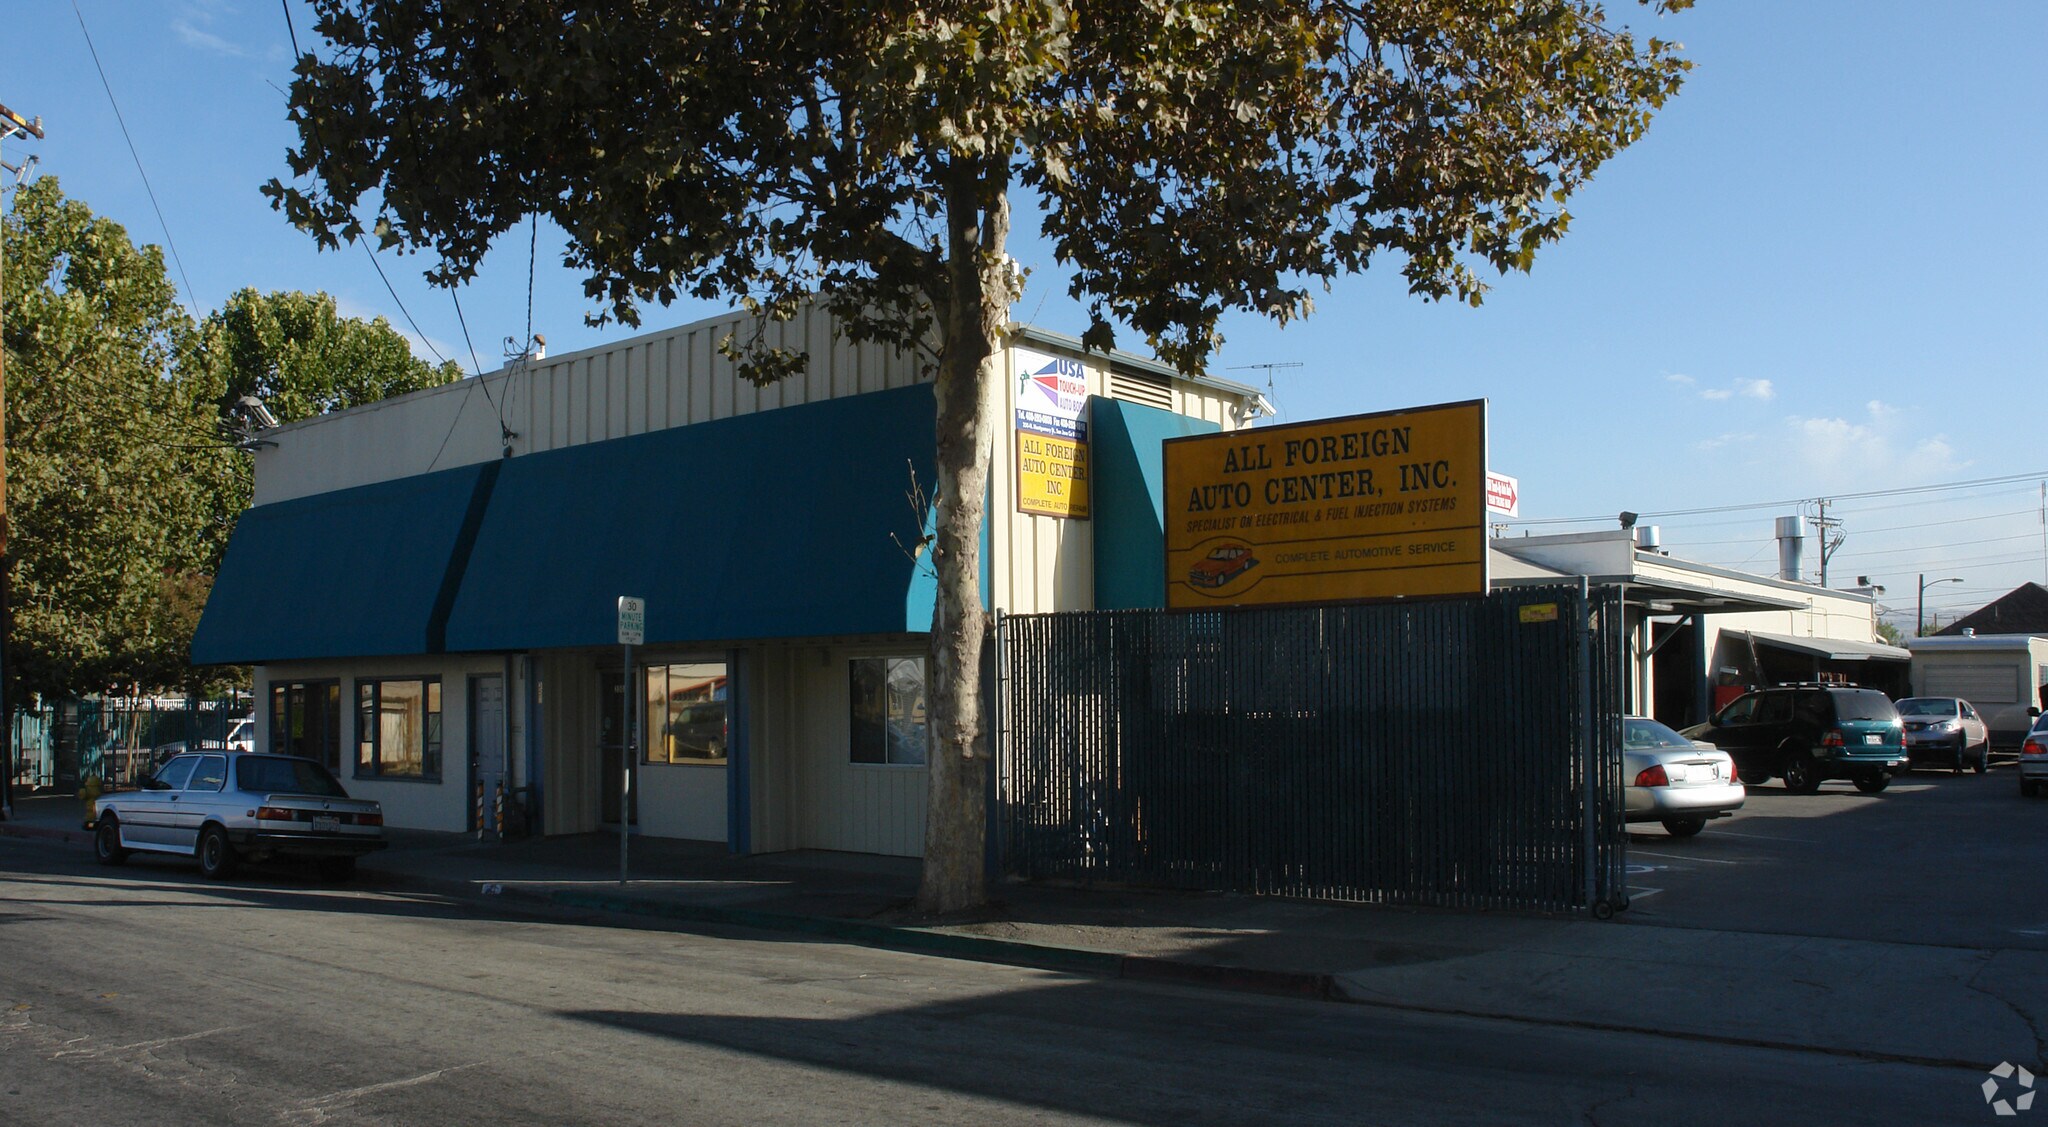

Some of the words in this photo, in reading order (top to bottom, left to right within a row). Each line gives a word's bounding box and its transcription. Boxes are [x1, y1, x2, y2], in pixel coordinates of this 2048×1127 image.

[1059, 358, 1085, 380] USA
[1061, 380, 1086, 397] TOUCH-UP
[1061, 397, 1073, 412] AUTO
[1024, 440, 1042, 455] ALL
[1047, 443, 1085, 463] FOREIGN
[1223, 445, 1272, 474] ALL
[1286, 427, 1411, 467] FOREIGN
[1023, 458, 1046, 475] AUTO
[1047, 480, 1065, 496] INC.
[1188, 482, 1251, 513] AUTO
[1265, 469, 1383, 506] CENTER,
[1400, 461, 1457, 493] INC.
[1023, 498, 1052, 509] COMPLETE
[1055, 502, 1068, 511] AUTO
[1188, 517, 1237, 534] SPECIALIST
[1241, 515, 1253, 530] ON
[1256, 510, 1309, 527] ELECTRICAL
[1314, 508, 1322, 522] &
[1326, 507, 1350, 521] FUEL
[1354, 502, 1405, 519] INJECTION
[1409, 497, 1457, 514] SYSTEMS
[1276, 551, 1330, 565] COMPLETE
[1335, 545, 1402, 561] AUTOMOTIVE
[1409, 541, 1456, 556] SERVICE
[628, 602, 637, 611] 30
[622, 612, 642, 622] MINUTE
[621, 621, 643, 631] PARKING
